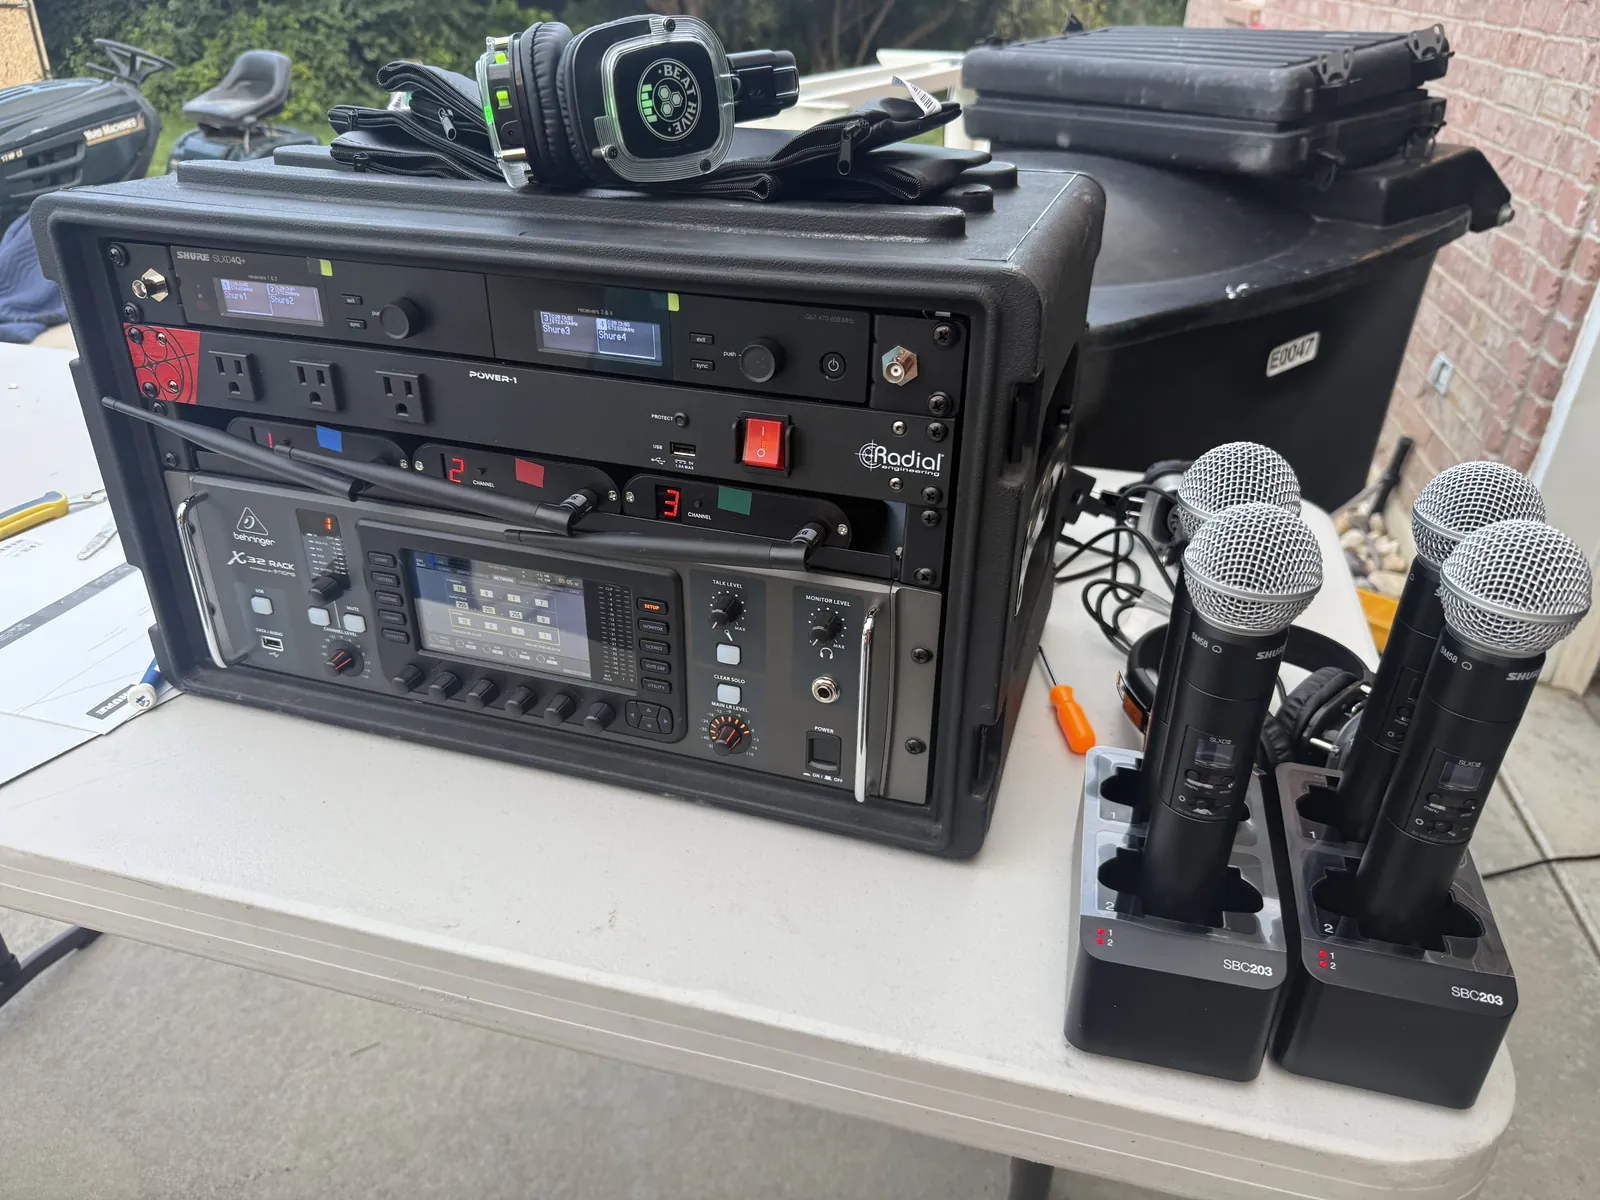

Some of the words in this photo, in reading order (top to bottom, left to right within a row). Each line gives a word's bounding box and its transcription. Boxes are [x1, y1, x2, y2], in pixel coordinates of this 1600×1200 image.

[663, 64, 696, 96] BEAT
[672, 101, 697, 134] HIVE
[176, 251, 210, 262] SHURE
[212, 254, 246, 265] SLXD4Q+
[223, 290, 248, 300] Shure1
[270, 294, 294, 305] Shure2
[542, 323, 571, 335] Shure3
[598, 330, 627, 342] Shure4
[1269, 337, 1315, 369] E0047
[469, 370, 517, 384] POWER-1
[651, 413, 673, 421] PROTECT
[874, 445, 941, 471] Radial
[450, 457, 464, 483] 2
[881, 465, 940, 477] engineering
[472, 479, 495, 488] CHANNEL
[664, 489, 680, 517] 3
[687, 511, 712, 521] CHANNEL
[232, 531, 276, 547] behringer
[268, 559, 295, 571] RACK
[805, 594, 833, 604] MONITOR
[833, 599, 851, 607] LEVEL
[644, 603, 660, 611] SETUP
[323, 626, 344, 635] CHANNEL
[1191, 631, 1209, 648] SM58
[1440, 645, 1458, 664] SM58
[713, 674, 731, 682] CLEAR
[711, 701, 725, 709] MAIN
[814, 725, 834, 734] POWER
[1423, 804, 1440, 814] menu
[1110, 811, 1116, 819] 1
[1309, 830, 1316, 839] 1
[1105, 901, 1115, 910] 2
[1108, 929, 1113, 937] 1
[1323, 923, 1334, 934] 2
[1107, 939, 1113, 947] 2
[1330, 952, 1335, 960] 1
[1223, 959, 1273, 977] SBC203
[1330, 962, 1336, 970] 2
[1451, 986, 1504, 1006] SBC203
